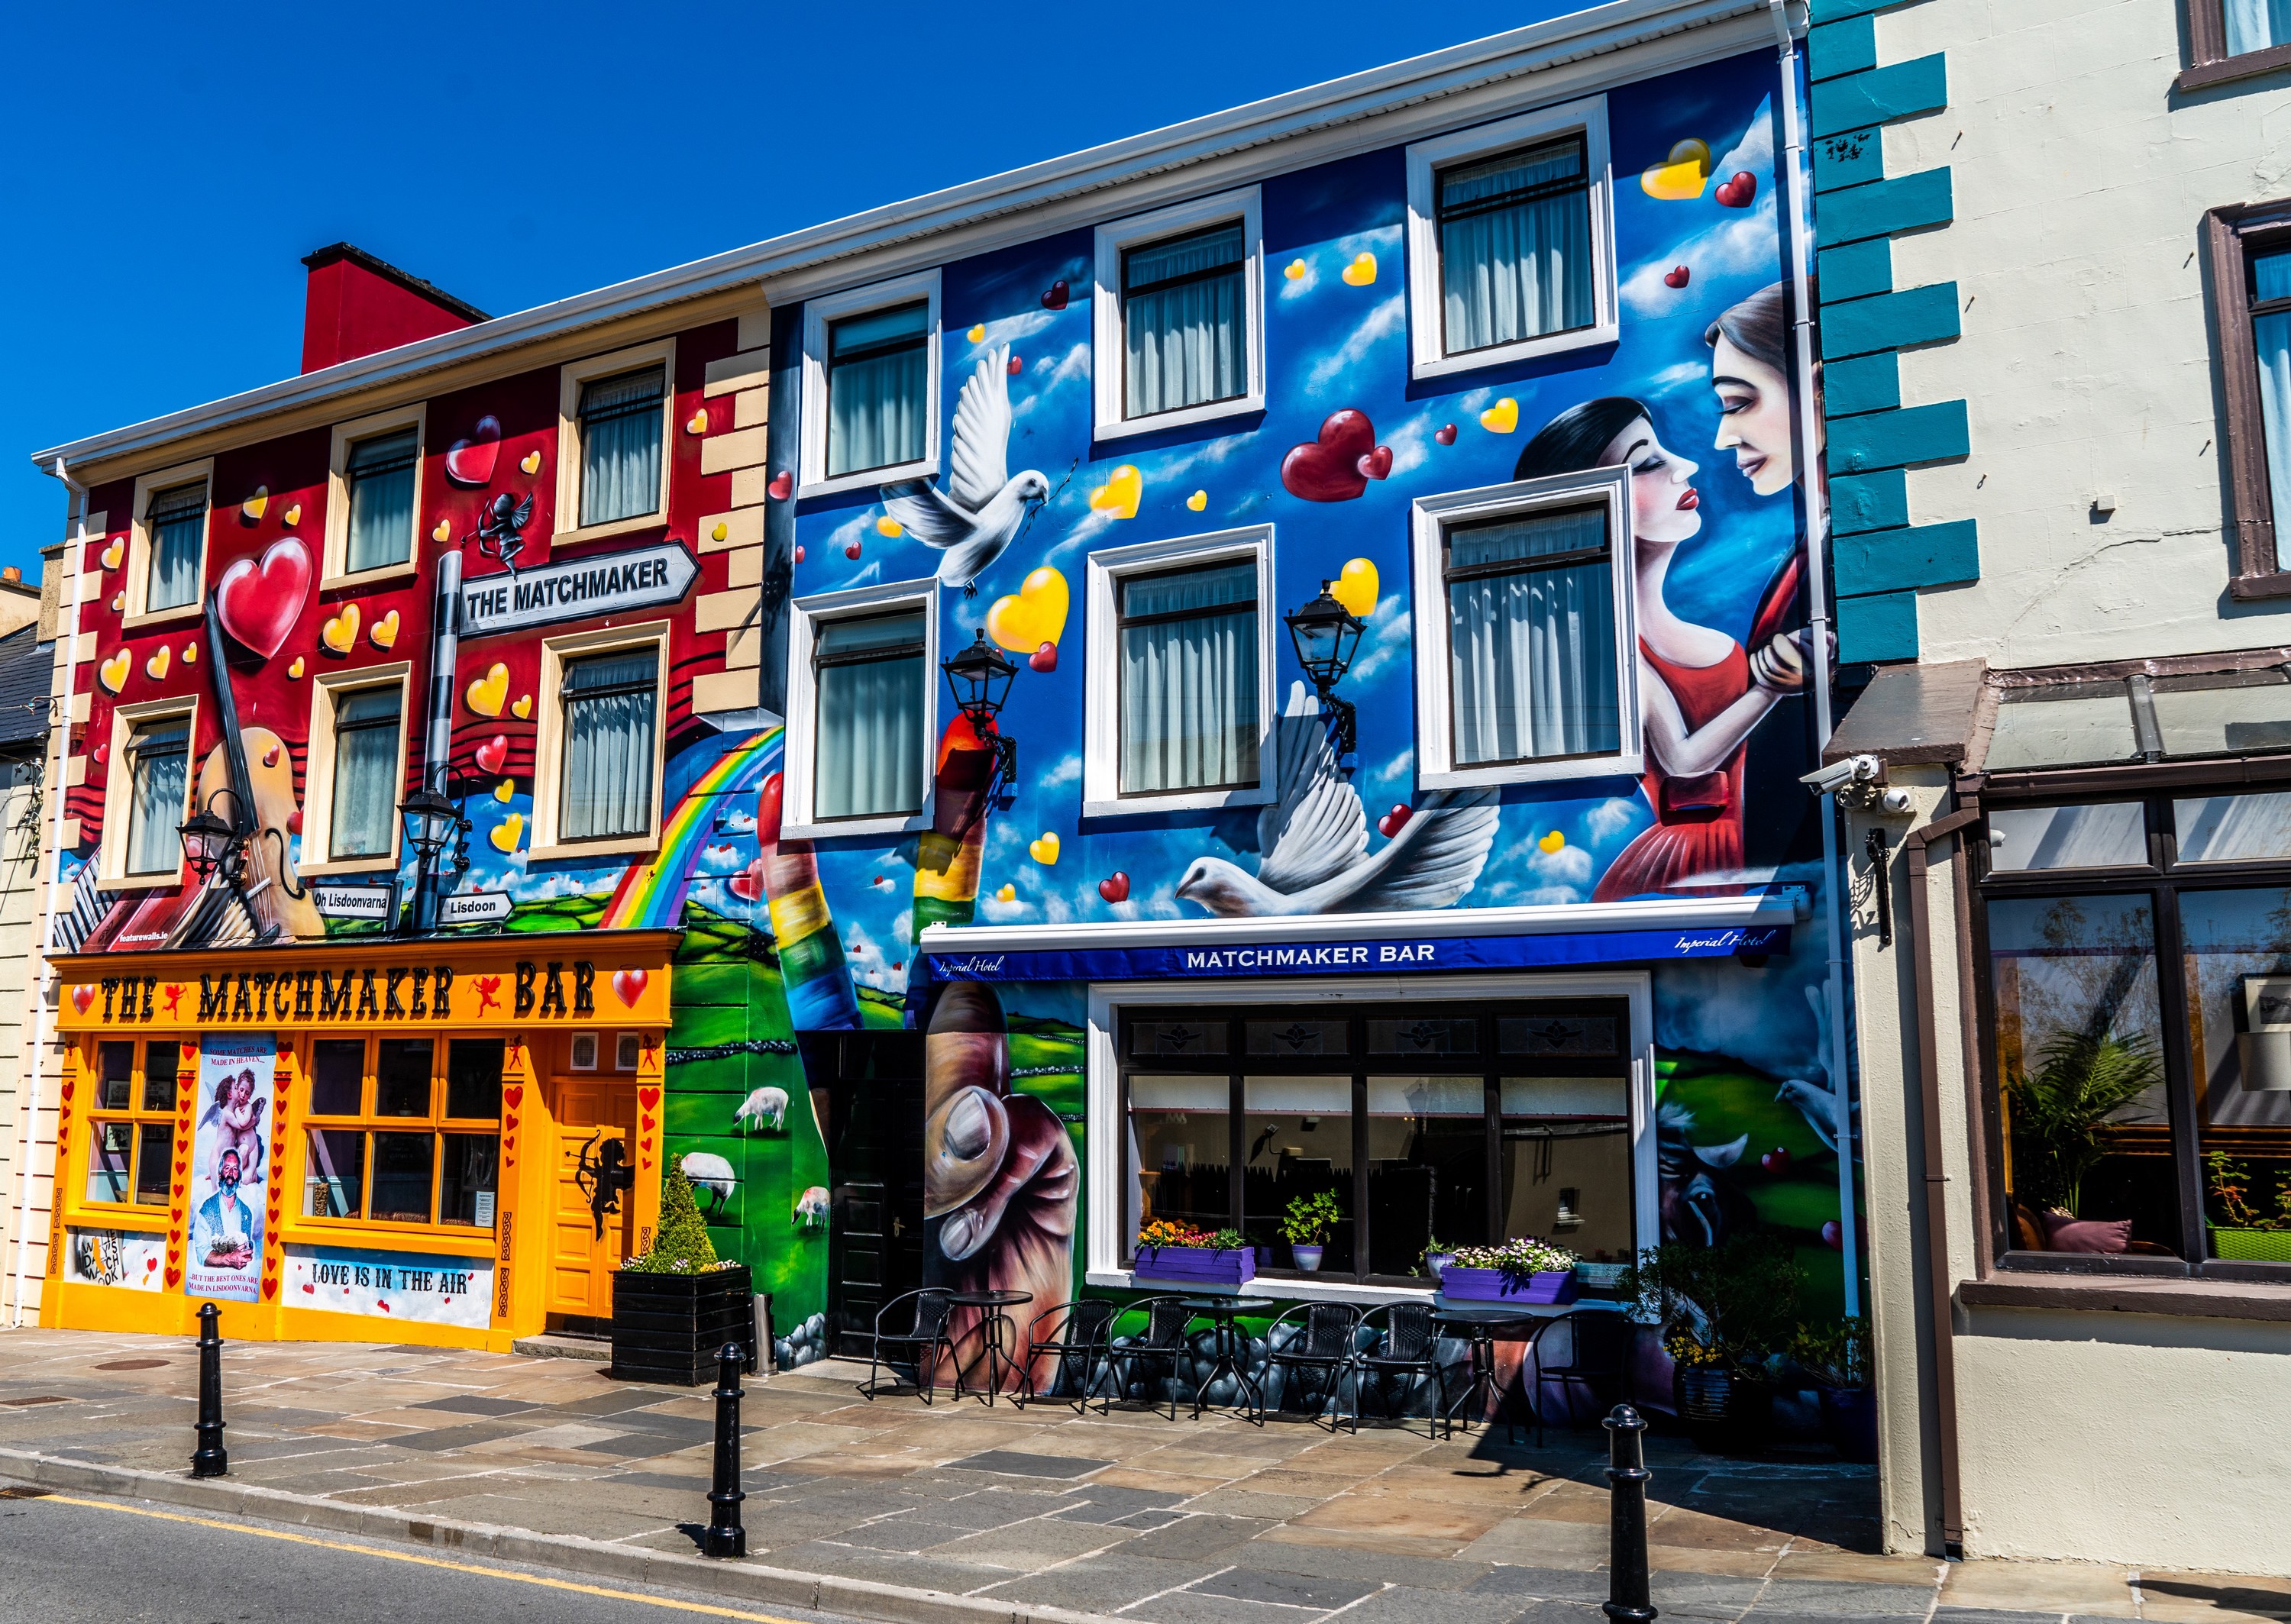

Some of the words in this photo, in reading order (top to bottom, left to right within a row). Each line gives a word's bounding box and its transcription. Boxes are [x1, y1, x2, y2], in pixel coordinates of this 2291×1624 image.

[467, 587, 508, 618] THE
[514, 558, 668, 611] MATCHMAKER
[315, 893, 327, 907] Oh
[328, 893, 386, 909] Lisdoonvarna
[450, 899, 496, 915] Lisdoon
[119, 931, 168, 943] featurewalls.ie
[1674, 931, 1734, 954] Imperial
[1728, 929, 1776, 946] Hotel
[974, 955, 1004, 971] Hotel
[1188, 947, 1368, 967] MATCHMAKER
[1379, 944, 1434, 962] BAR
[100, 977, 157, 1019] THE
[197, 966, 454, 1018] MATCHMAKER
[515, 961, 596, 1013] BAR
[209, 1048, 227, 1056] SOME
[227, 1046, 255, 1055] MATCHES
[256, 1046, 267, 1054] ARE
[211, 1057, 228, 1066] MADE
[189, 1282, 204, 1291] MADE
[247, 1276, 258, 1285] ARE
[312, 1264, 349, 1285] LOVE
[354, 1267, 370, 1287] IS
[375, 1268, 393, 1290] IN
[398, 1270, 433, 1292] THE
[438, 1273, 467, 1294] AIR
